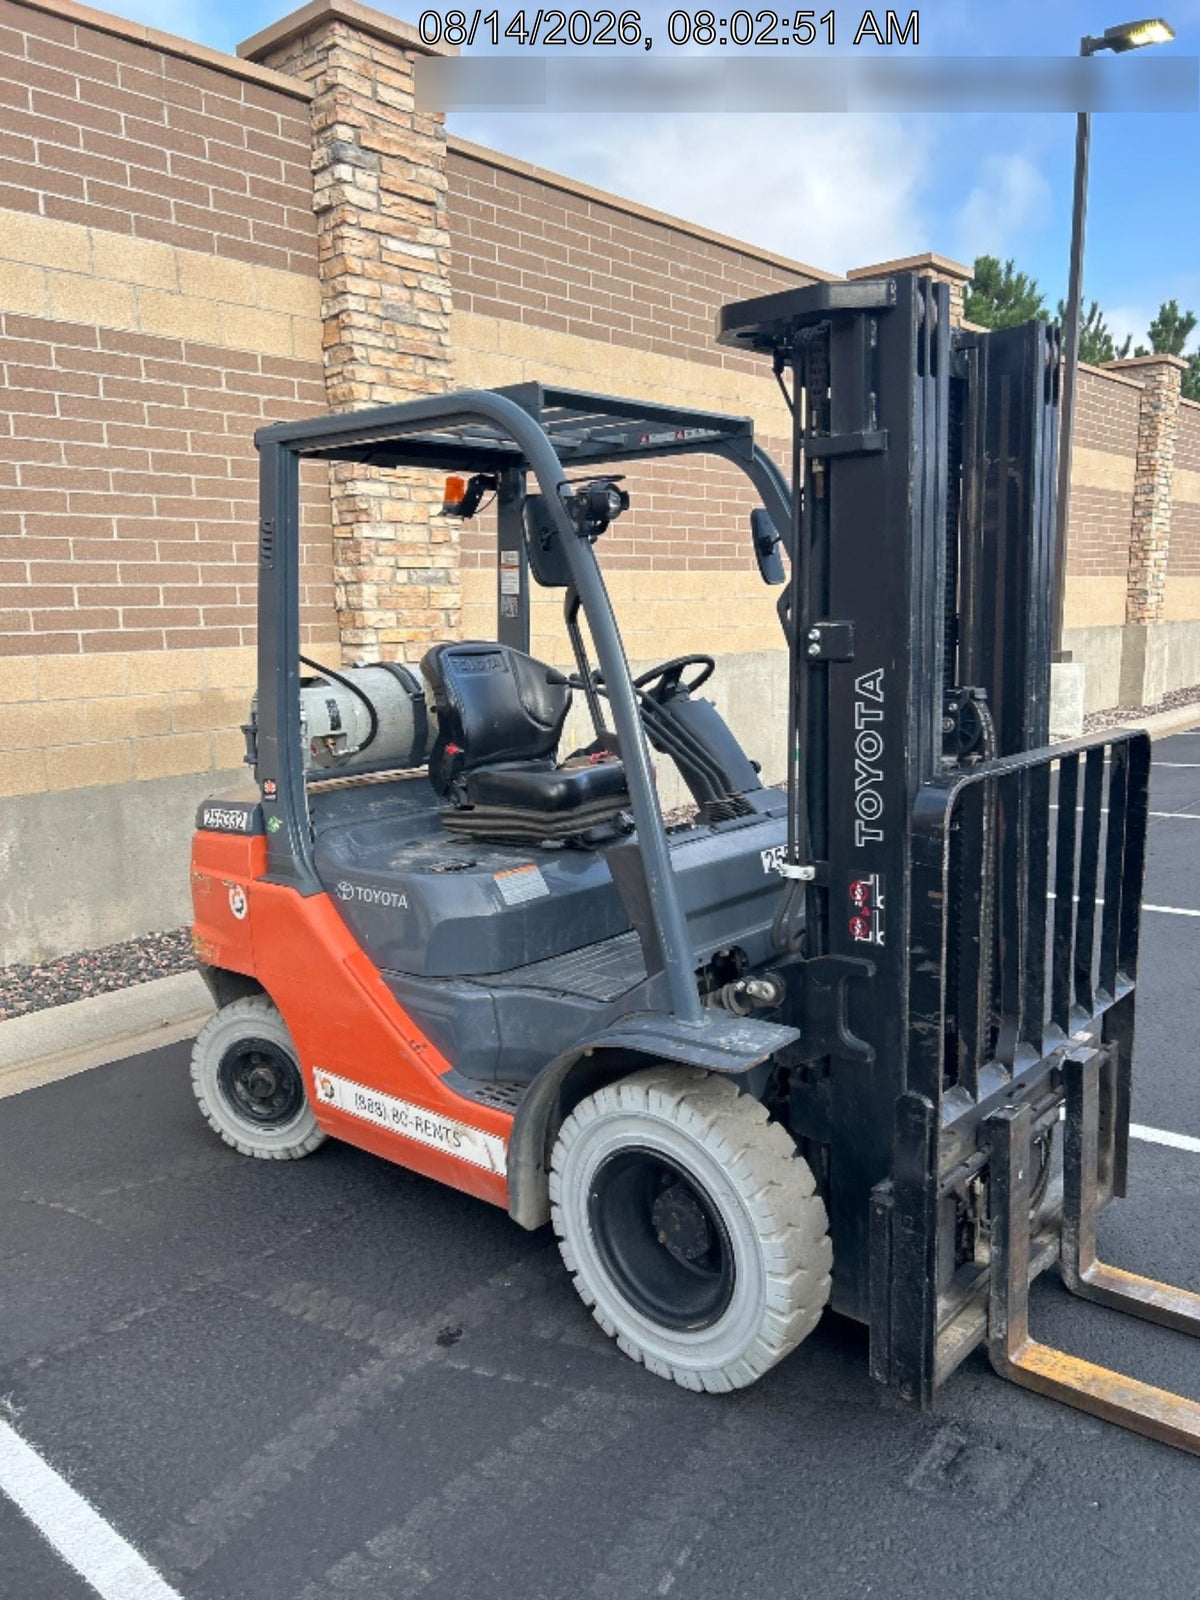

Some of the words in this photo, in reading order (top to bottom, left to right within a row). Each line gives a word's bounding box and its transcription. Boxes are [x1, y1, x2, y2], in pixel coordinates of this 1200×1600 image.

[854, 667, 885, 847] TOYOTA
[355, 886, 408, 909] TOYOTA
[354, 1093, 386, 1121] (888)
